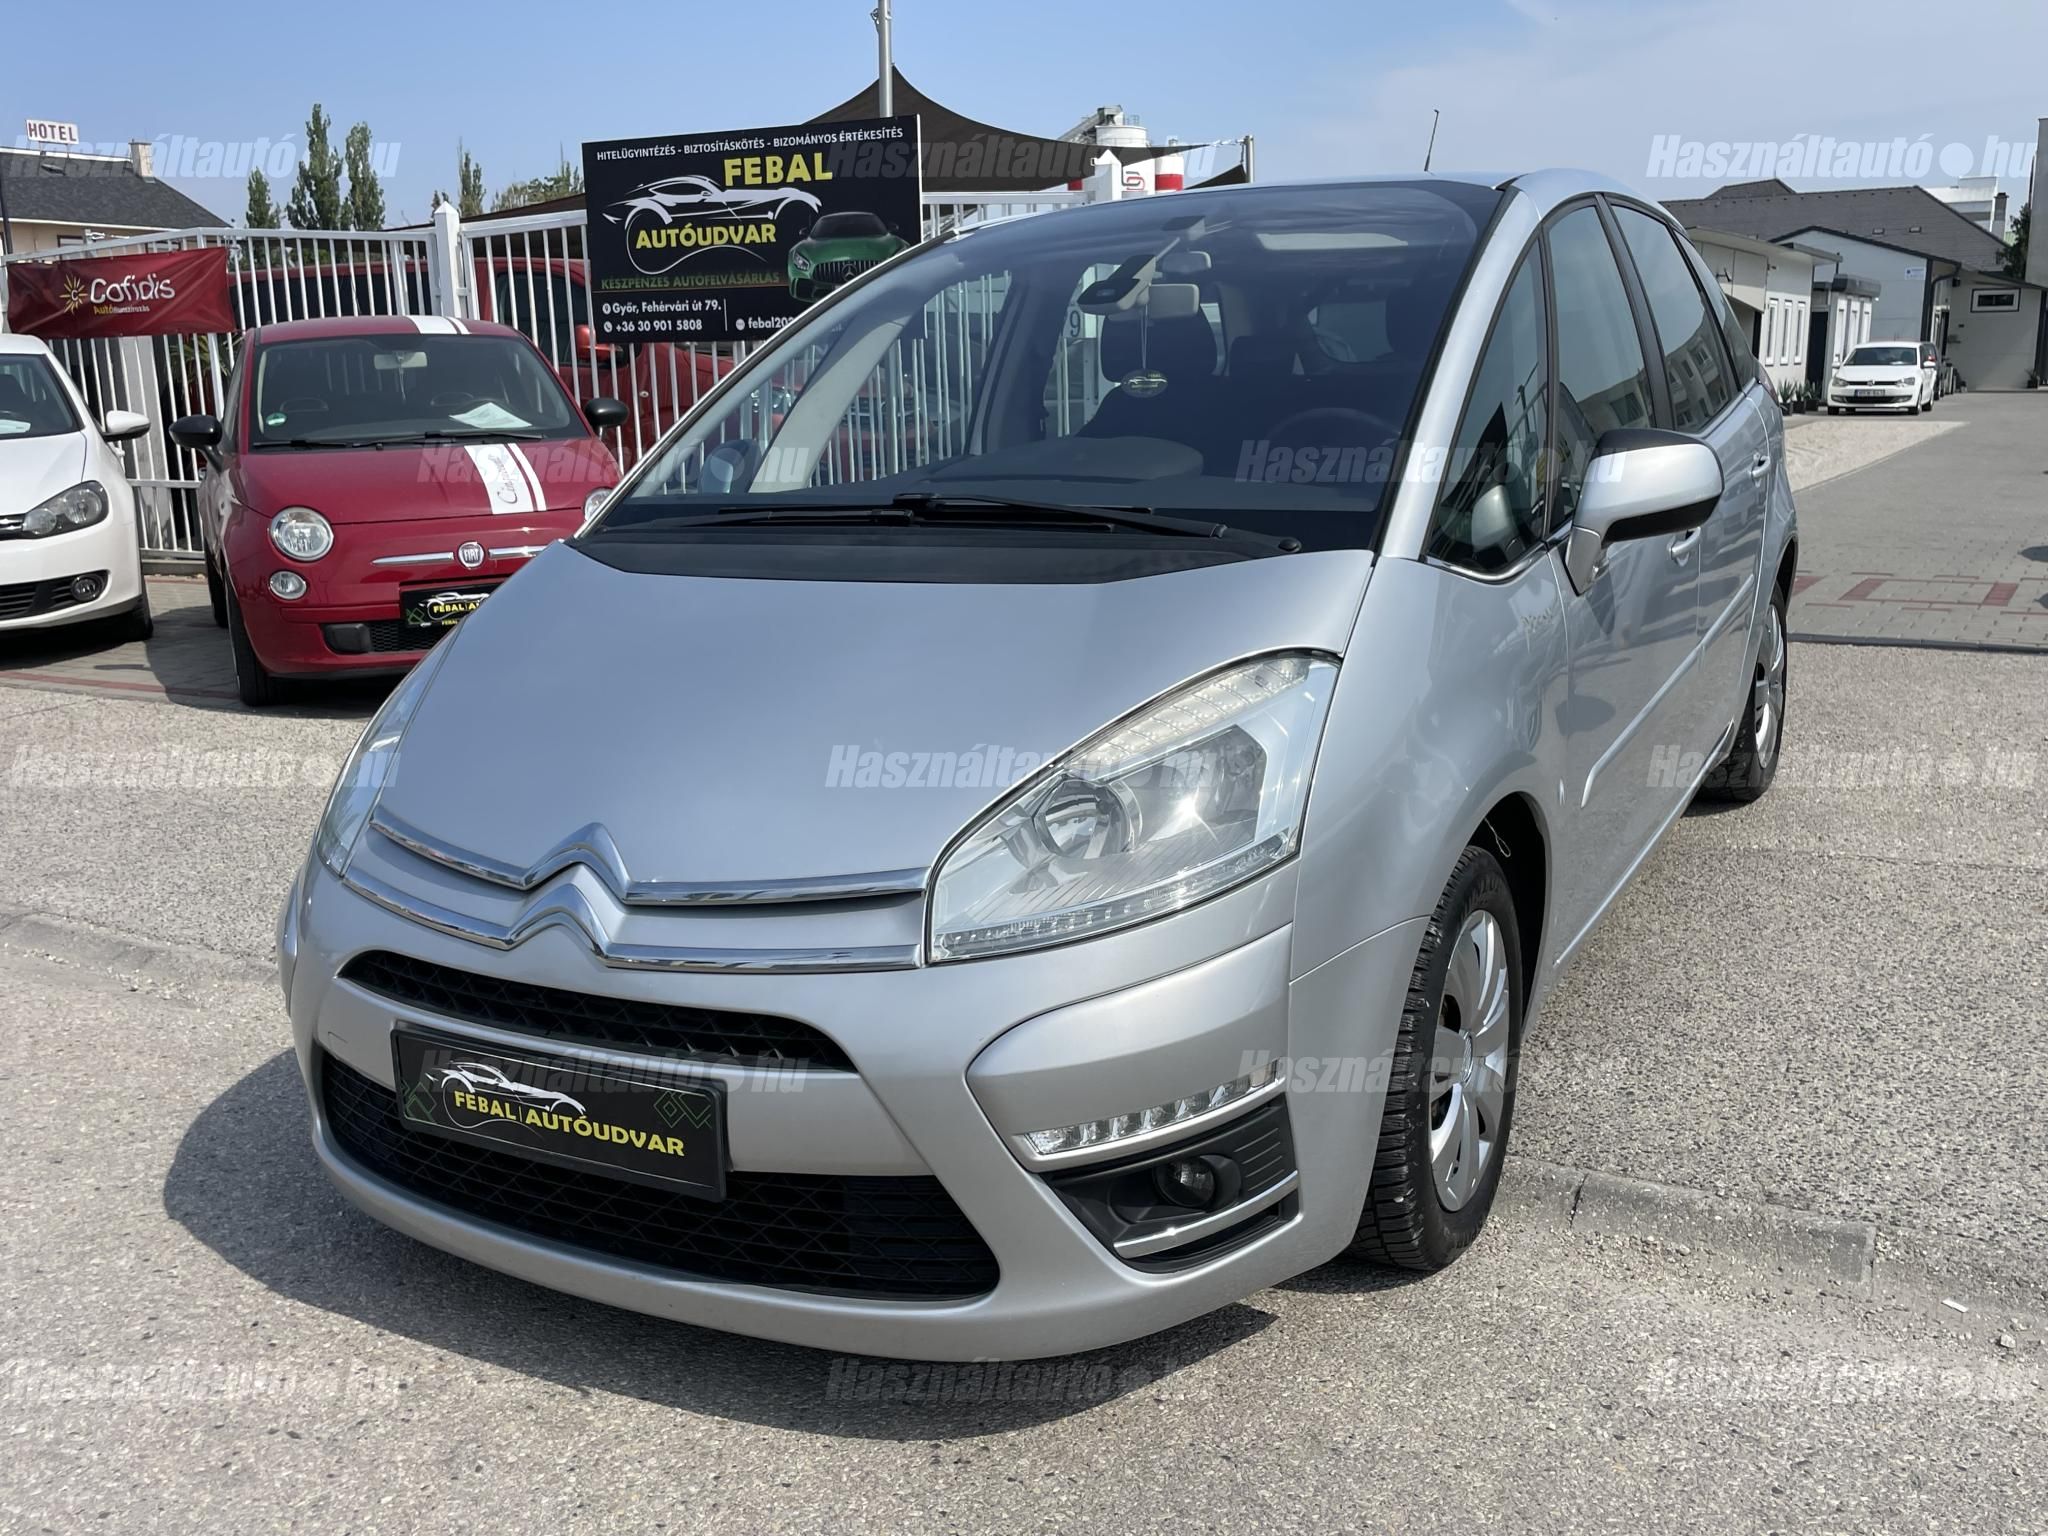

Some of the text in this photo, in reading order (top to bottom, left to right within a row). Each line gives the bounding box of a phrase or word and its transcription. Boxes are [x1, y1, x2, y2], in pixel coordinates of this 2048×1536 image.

[28, 121, 78, 143] HOTEL
[597, 145, 676, 160] HITELÜGYINTÉZÉS
[684, 137, 765, 154] BIZTOSÍTÁSKÖTÉS
[773, 133, 838, 147] BIZOMÁNYOS
[839, 126, 903, 142] ÉRTÉKESÍTÉS
[724, 152, 833, 186] FEBAL
[636, 223, 776, 249] AUTÓUDVAR
[90, 273, 175, 303] Cofidis
[612, 299, 721, 316] Győr, Fehérvári út 79.
[616, 319, 703, 332] +36 30 901 5808
[464, 548, 479, 561] FIAT
[433, 603, 465, 613] FEBAL
[454, 1090, 685, 1156] FEBAL AUTÓUDVAR
